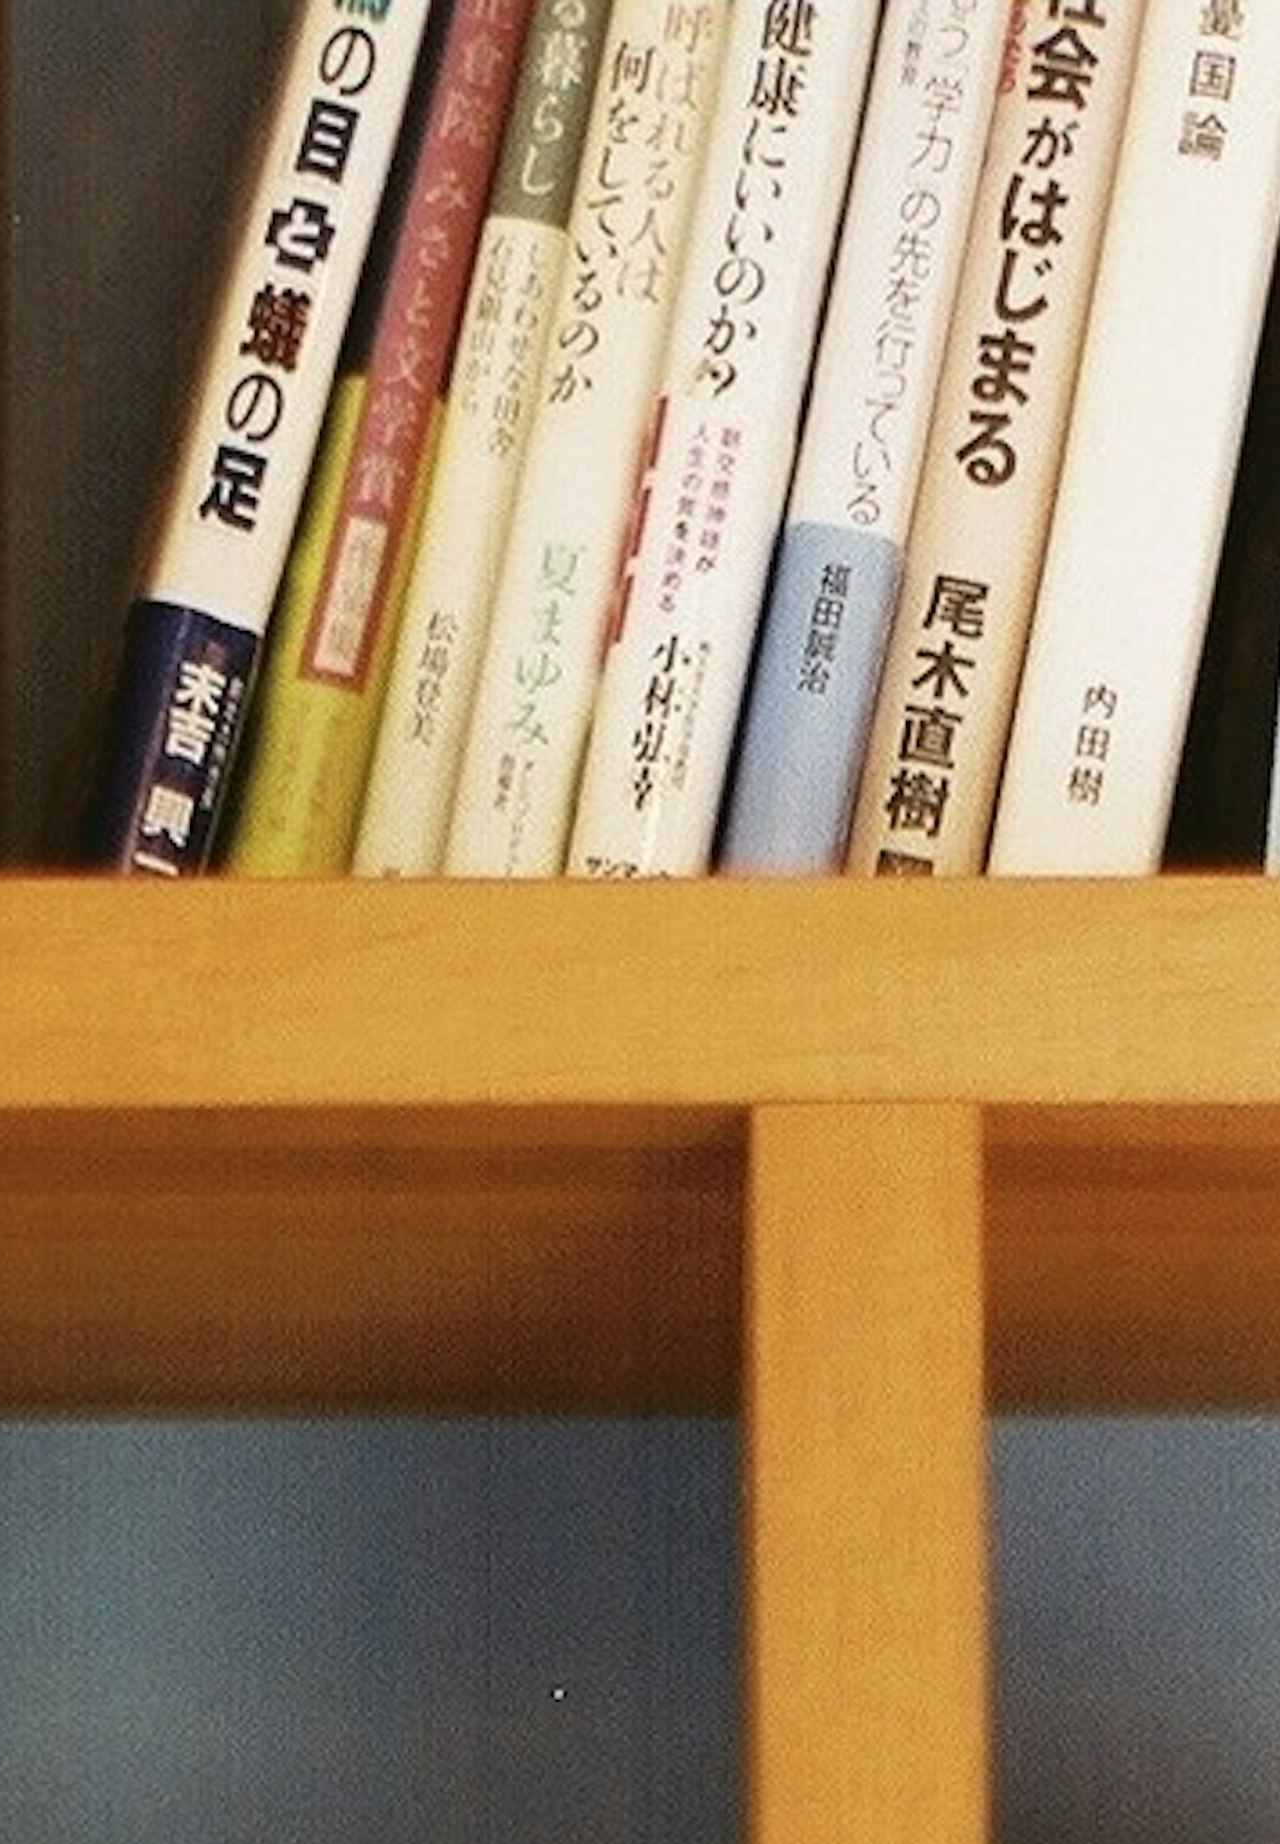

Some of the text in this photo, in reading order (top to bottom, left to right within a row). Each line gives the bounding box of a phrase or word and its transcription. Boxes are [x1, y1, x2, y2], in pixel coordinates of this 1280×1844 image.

[549, 40, 658, 404] 何をしているのか
[164, 660, 228, 768] 末吉
[884, 572, 990, 841] 尾木直樹
[1067, 681, 1118, 806] 内田樹
